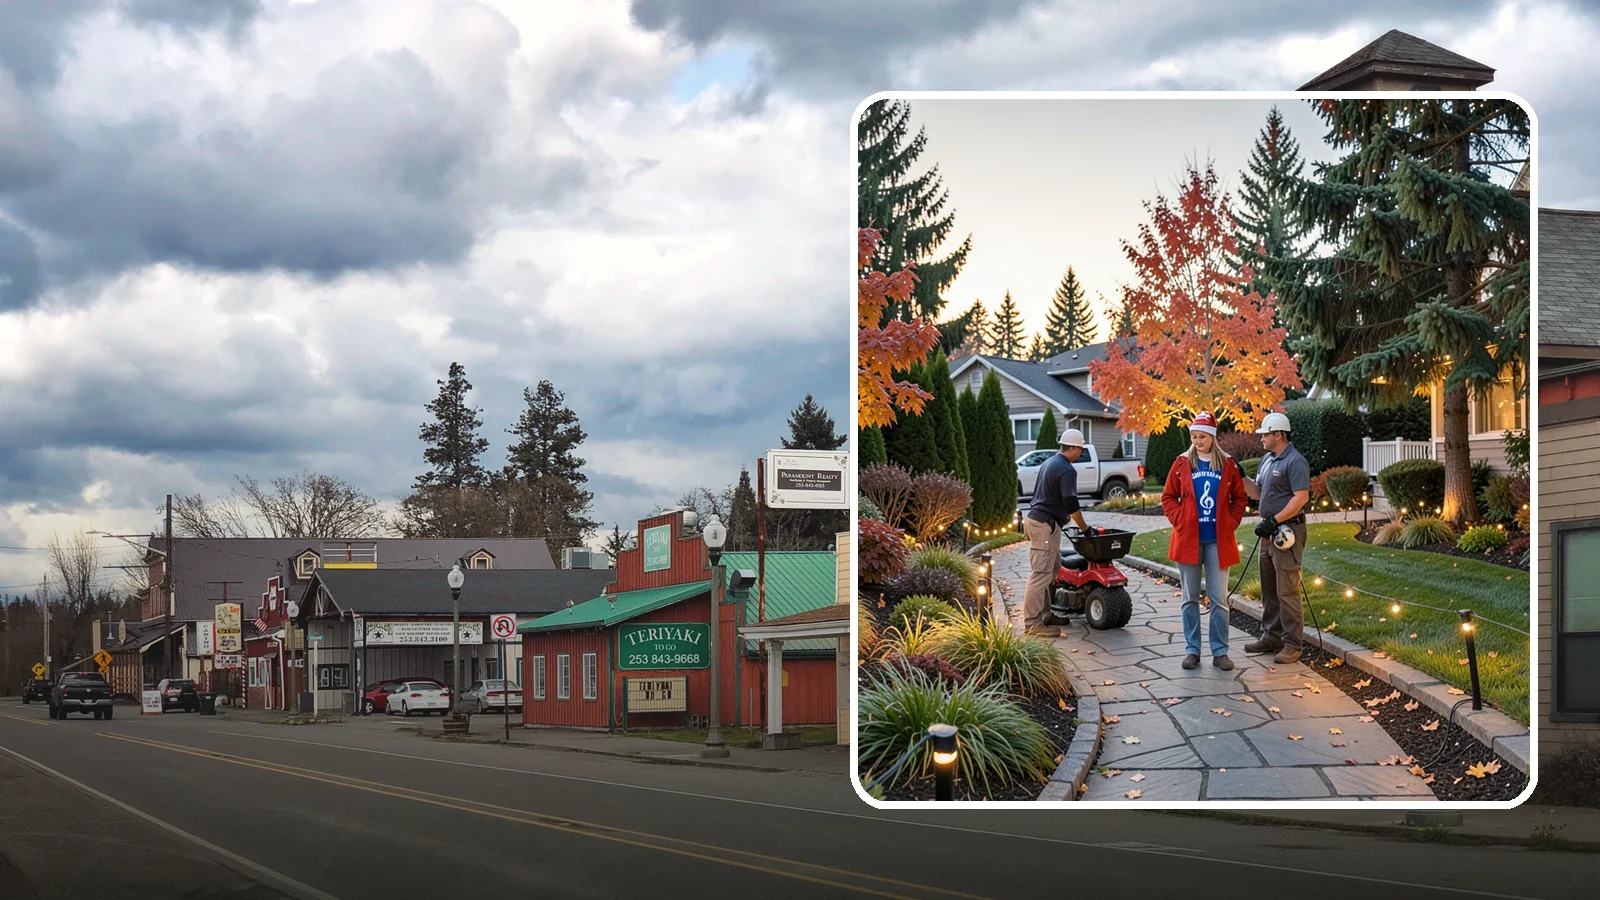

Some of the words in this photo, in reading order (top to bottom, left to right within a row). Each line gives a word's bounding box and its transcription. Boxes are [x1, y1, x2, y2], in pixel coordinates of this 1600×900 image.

[817, 472, 838, 480] REALTY
[625, 627, 702, 646] TERIYAKI
[628, 654, 648, 665] 253
[651, 654, 700, 664] 843-9668
